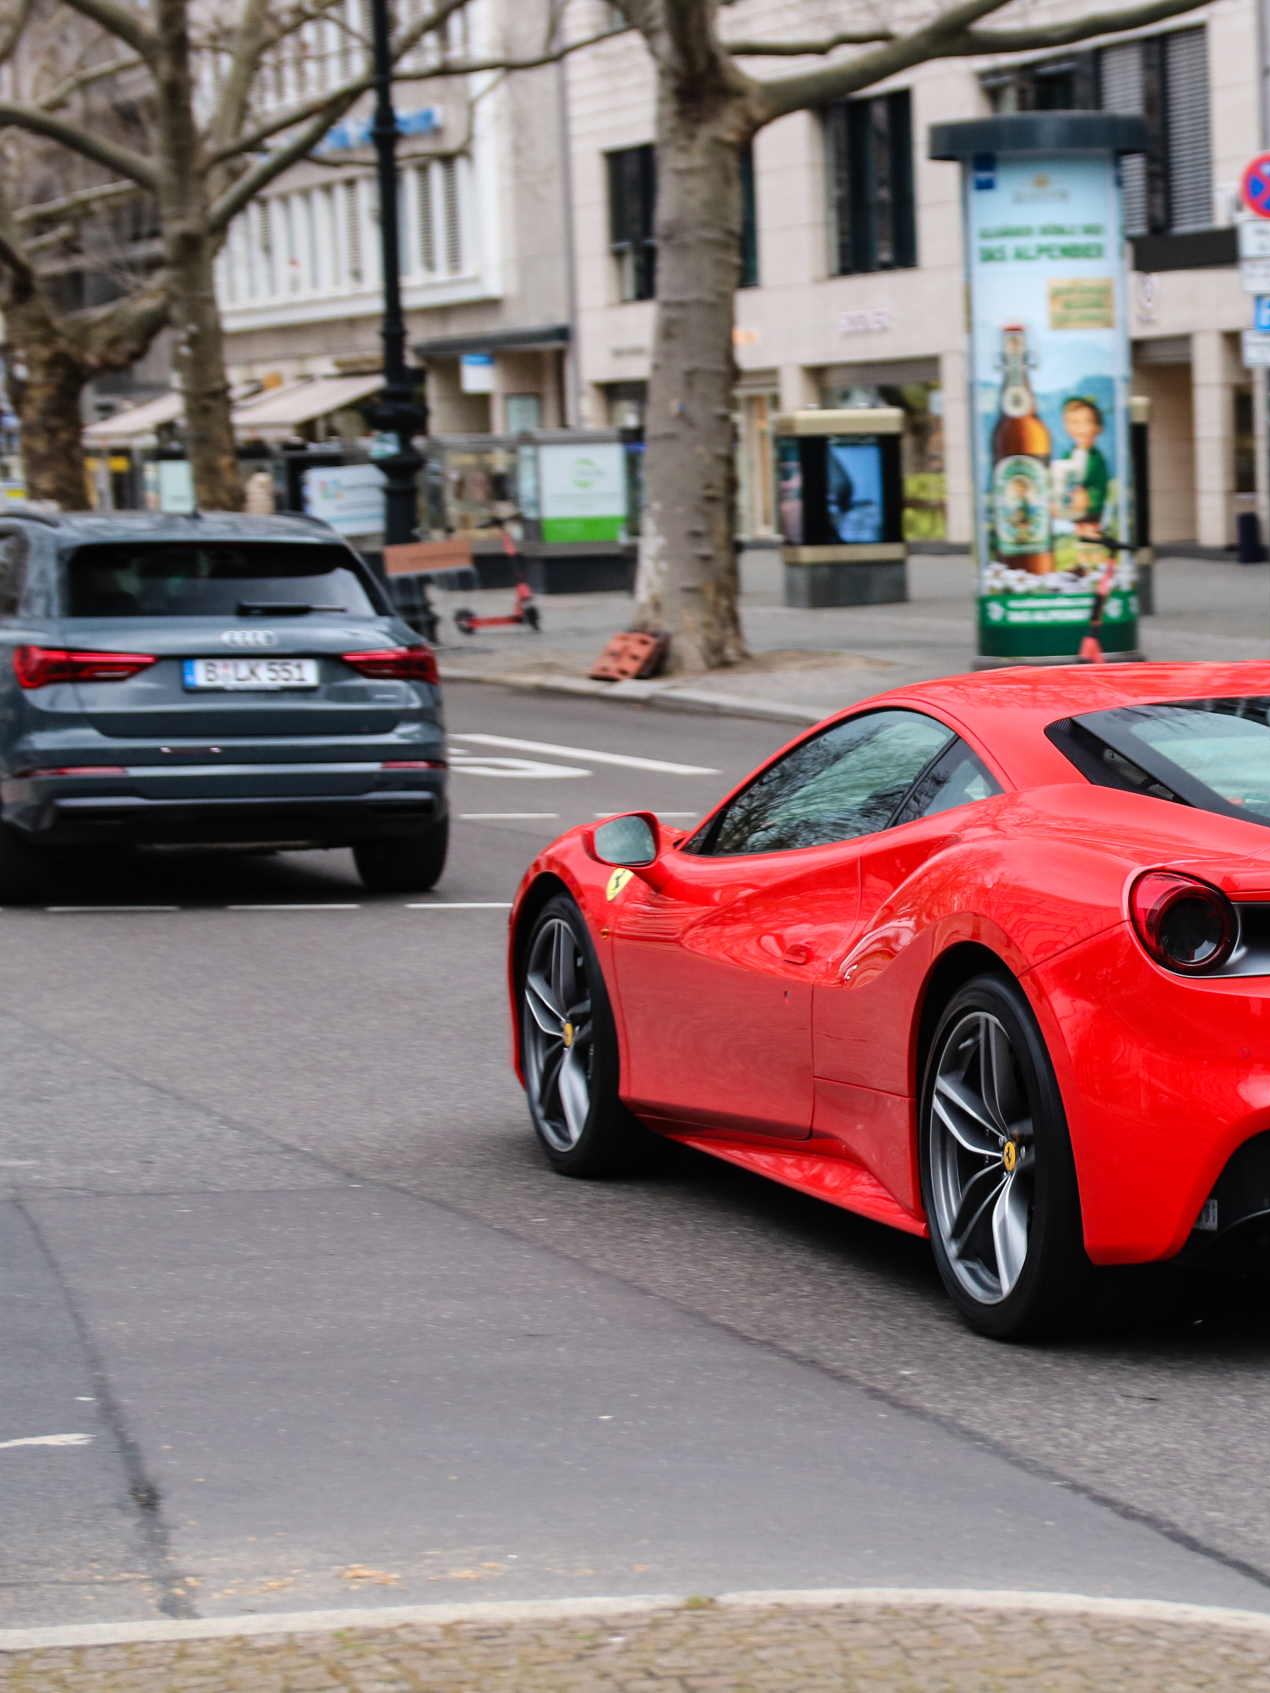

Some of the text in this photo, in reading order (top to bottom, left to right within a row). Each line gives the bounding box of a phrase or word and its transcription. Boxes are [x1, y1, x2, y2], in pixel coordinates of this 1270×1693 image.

[204, 661, 307, 682] B LK 551
